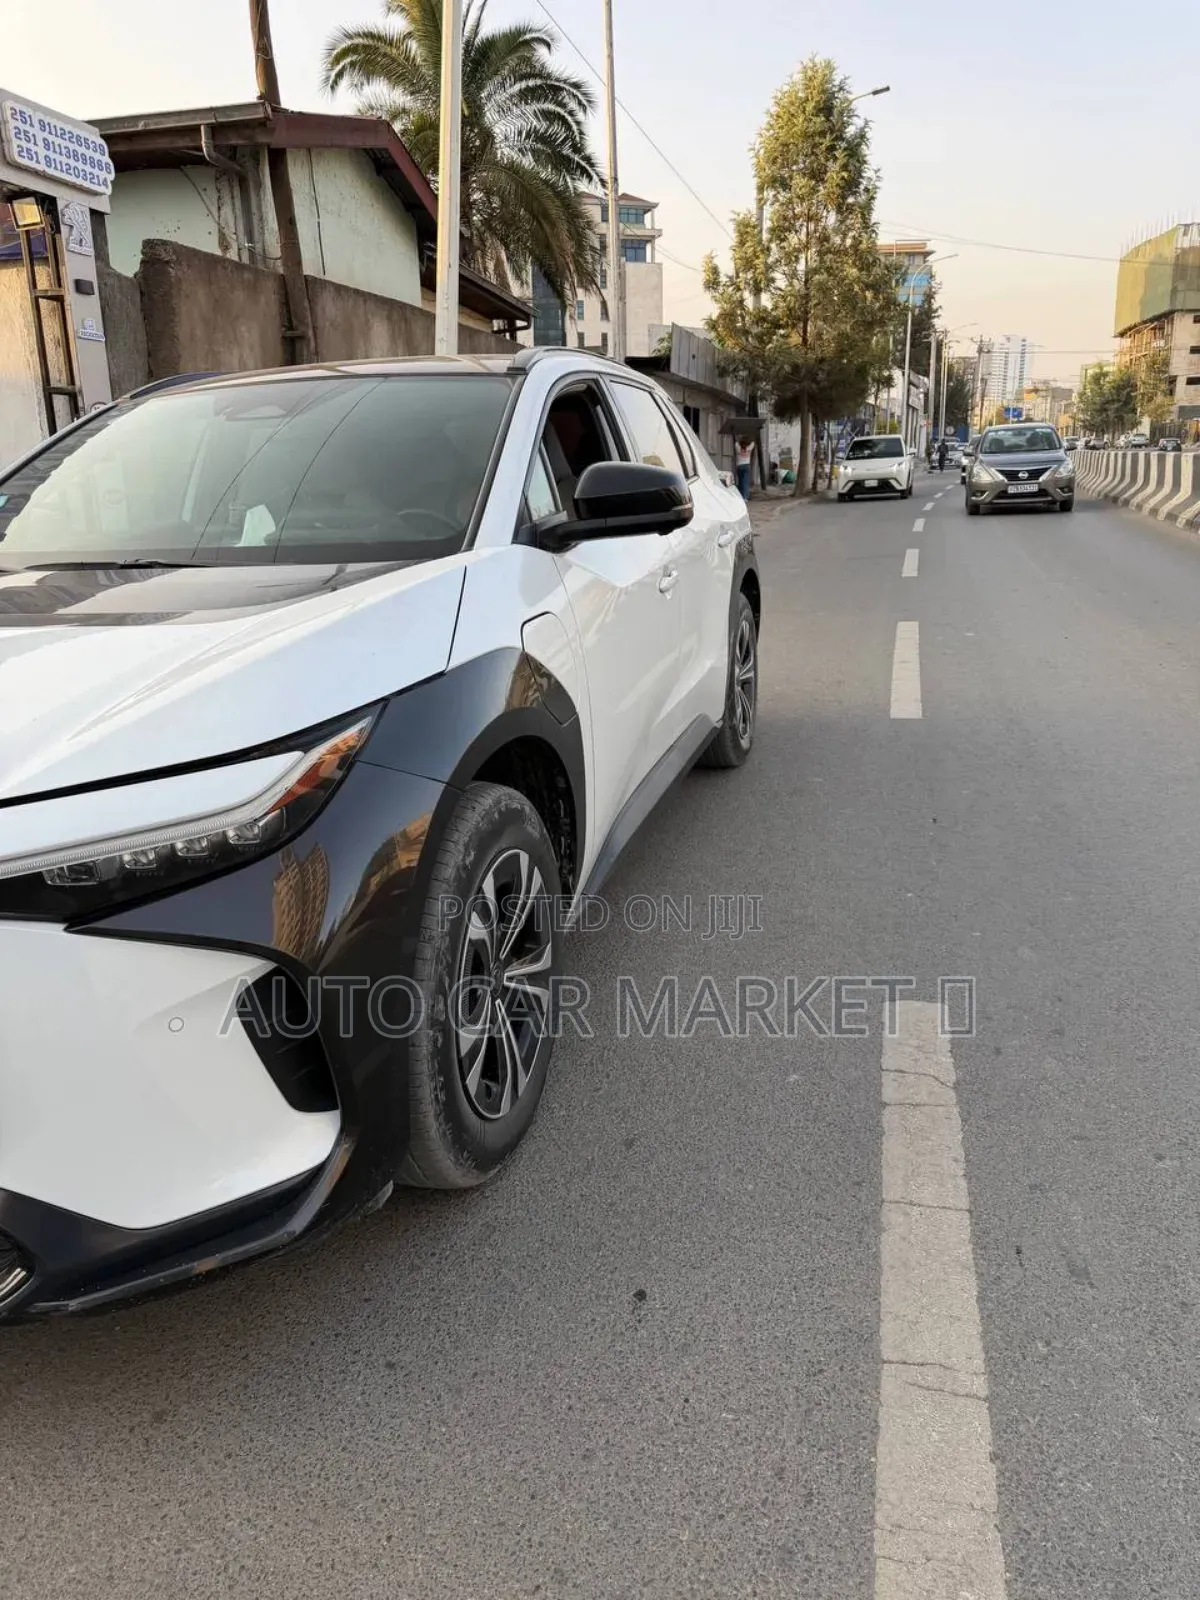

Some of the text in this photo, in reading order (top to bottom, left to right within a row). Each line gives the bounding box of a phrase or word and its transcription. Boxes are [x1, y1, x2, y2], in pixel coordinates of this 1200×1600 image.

[10, 107, 106, 156] 251 911226539
[14, 126, 39, 147] 251
[17, 144, 41, 164] 251
